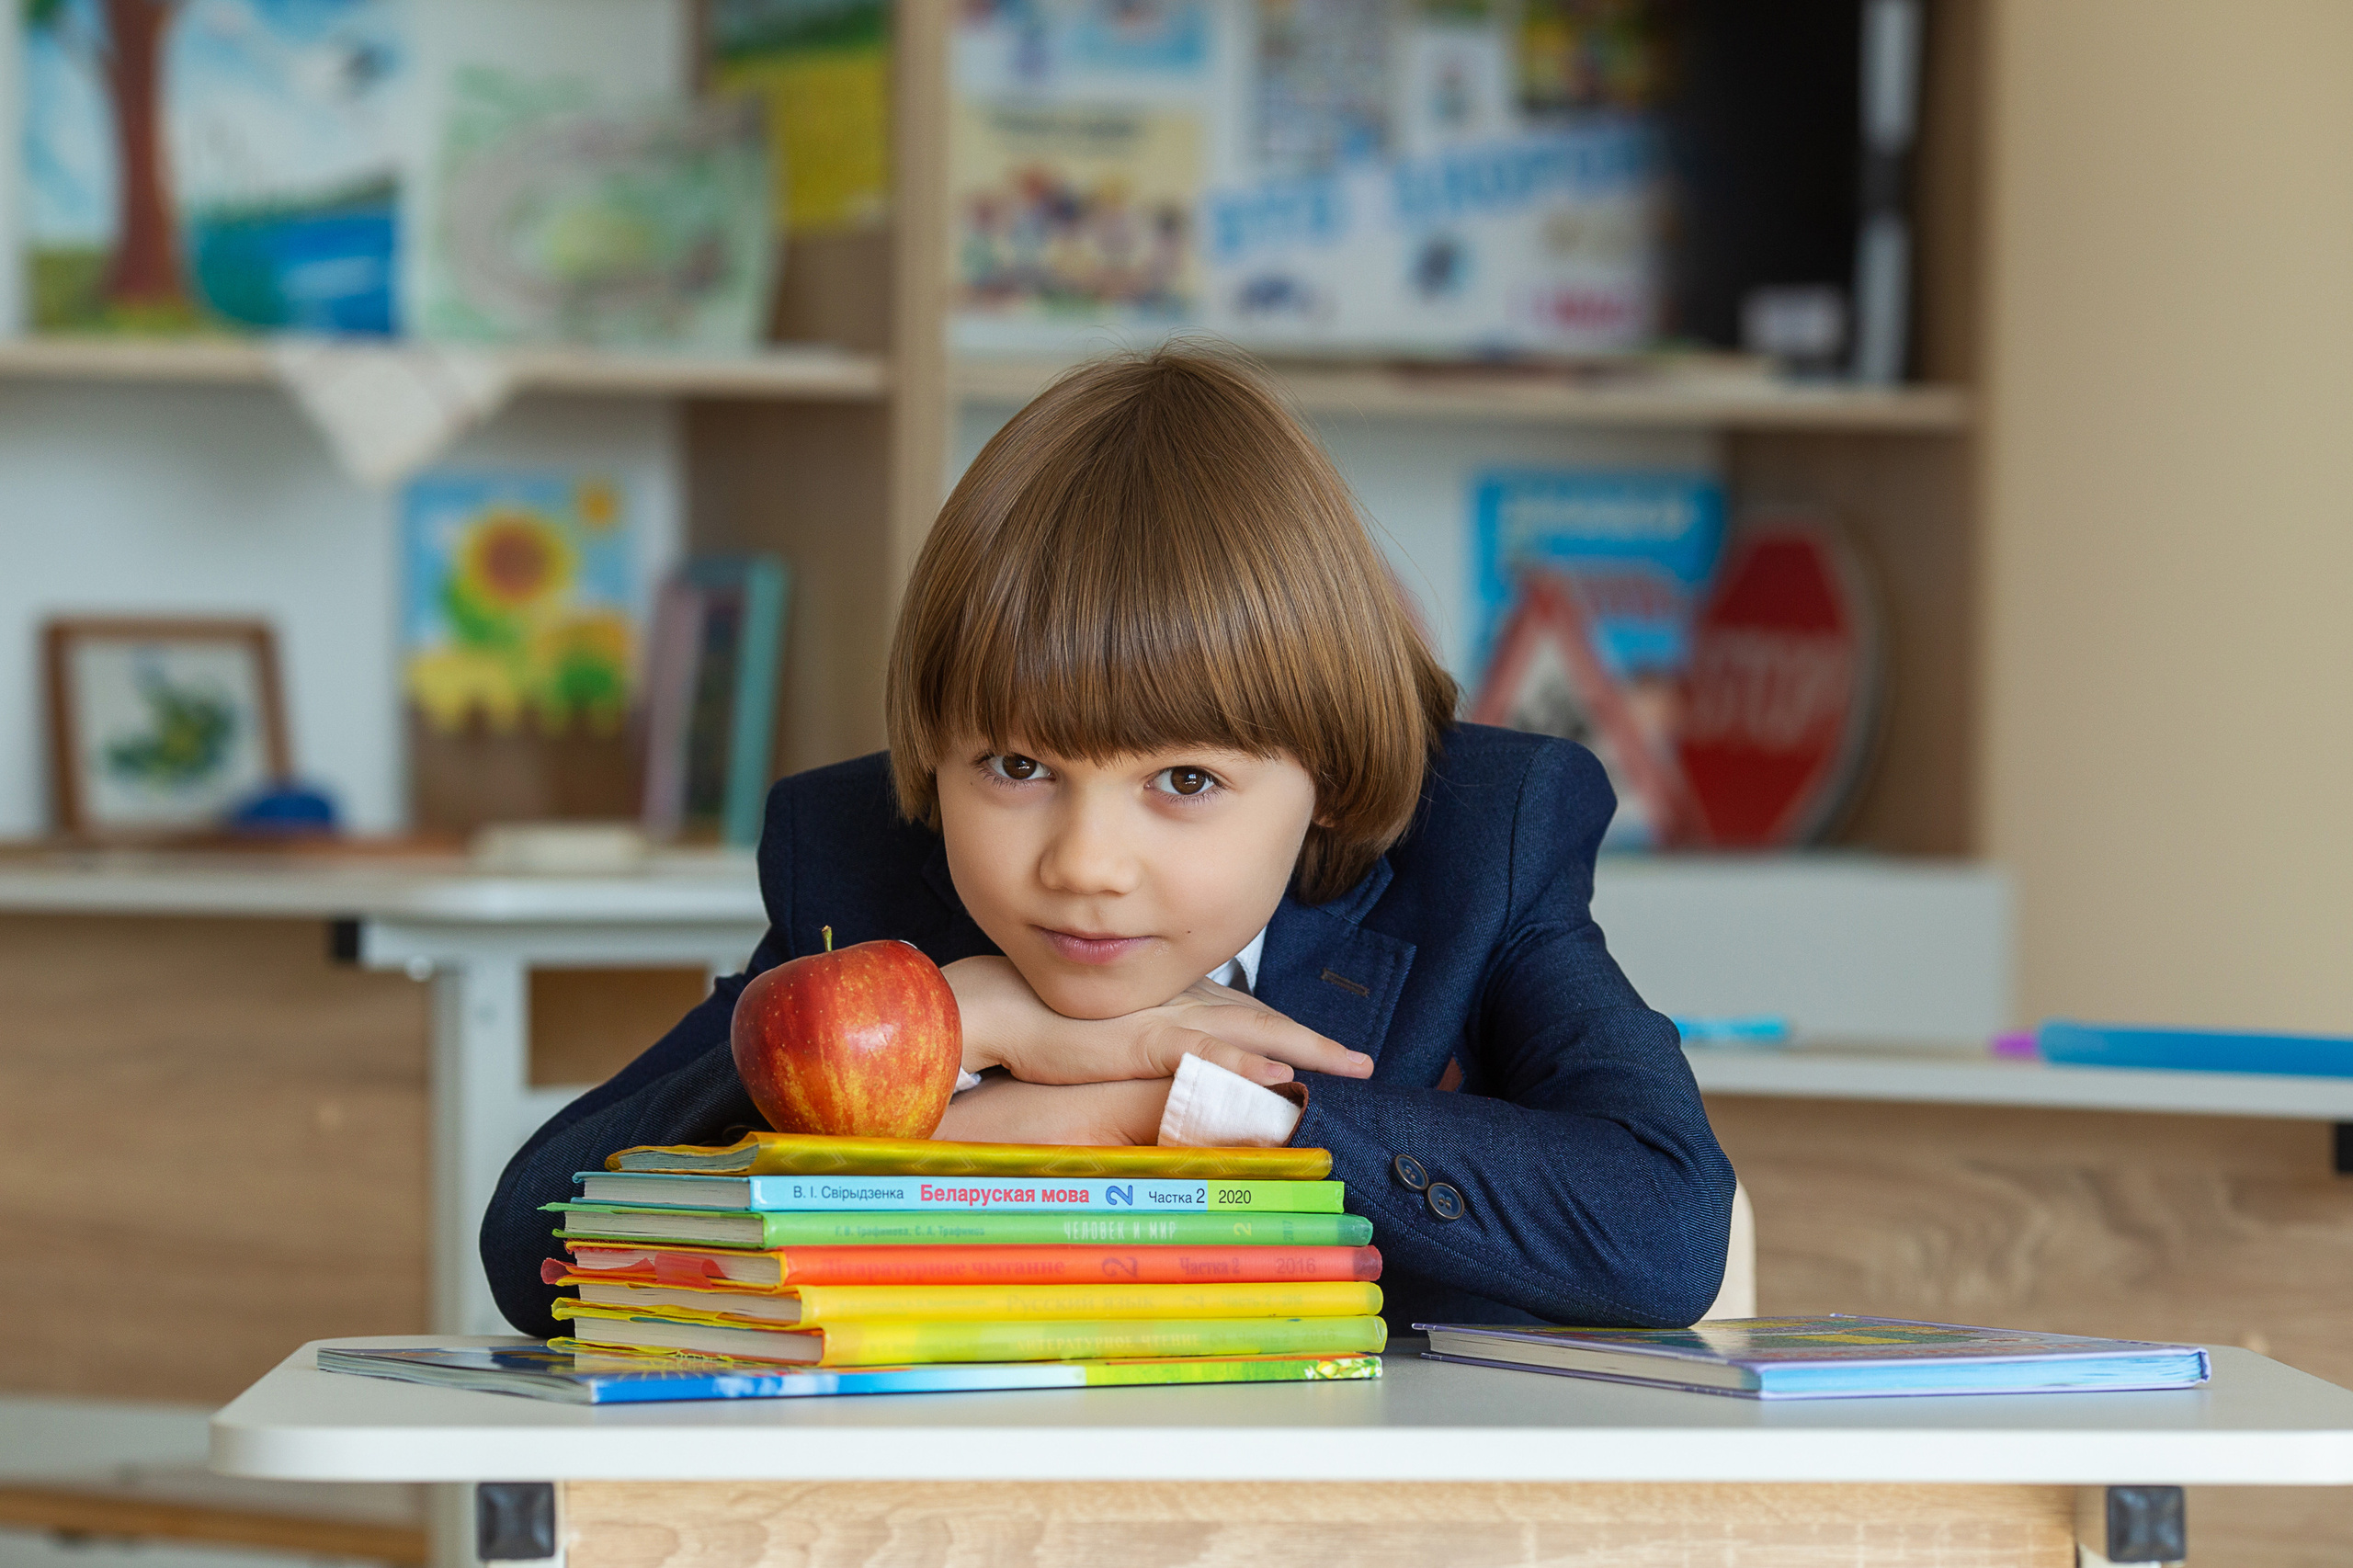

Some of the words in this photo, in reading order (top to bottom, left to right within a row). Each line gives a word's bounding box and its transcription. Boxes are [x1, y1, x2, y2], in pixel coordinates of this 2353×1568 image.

[792, 1186, 806, 1199] В.
[821, 1186, 904, 1200] Свірыдзенка
[920, 1184, 1036, 1206] Беларуская
[1041, 1188, 1090, 1203] мова
[1105, 1184, 1133, 1206] 2
[1148, 1190, 1193, 1204] Частка
[1196, 1187, 1206, 1204] 2
[1218, 1189, 1252, 1204] 2020
[1063, 1221, 1125, 1241] ЧЕЛОВЕК
[1133, 1221, 1141, 1239] И
[1149, 1221, 1176, 1239] МИР
[1233, 1221, 1252, 1236] 2
[972, 1260, 1066, 1277] чытанне
[1101, 1256, 1139, 1278] 2
[1179, 1256, 1229, 1276] Частка
[1232, 1257, 1240, 1275] 2
[1276, 1257, 1316, 1275] 2016
[1006, 1294, 1095, 1316] Русский
[1102, 1295, 1155, 1311] язык
[1141, 1333, 1201, 1348] ЧТЕНИЕ
